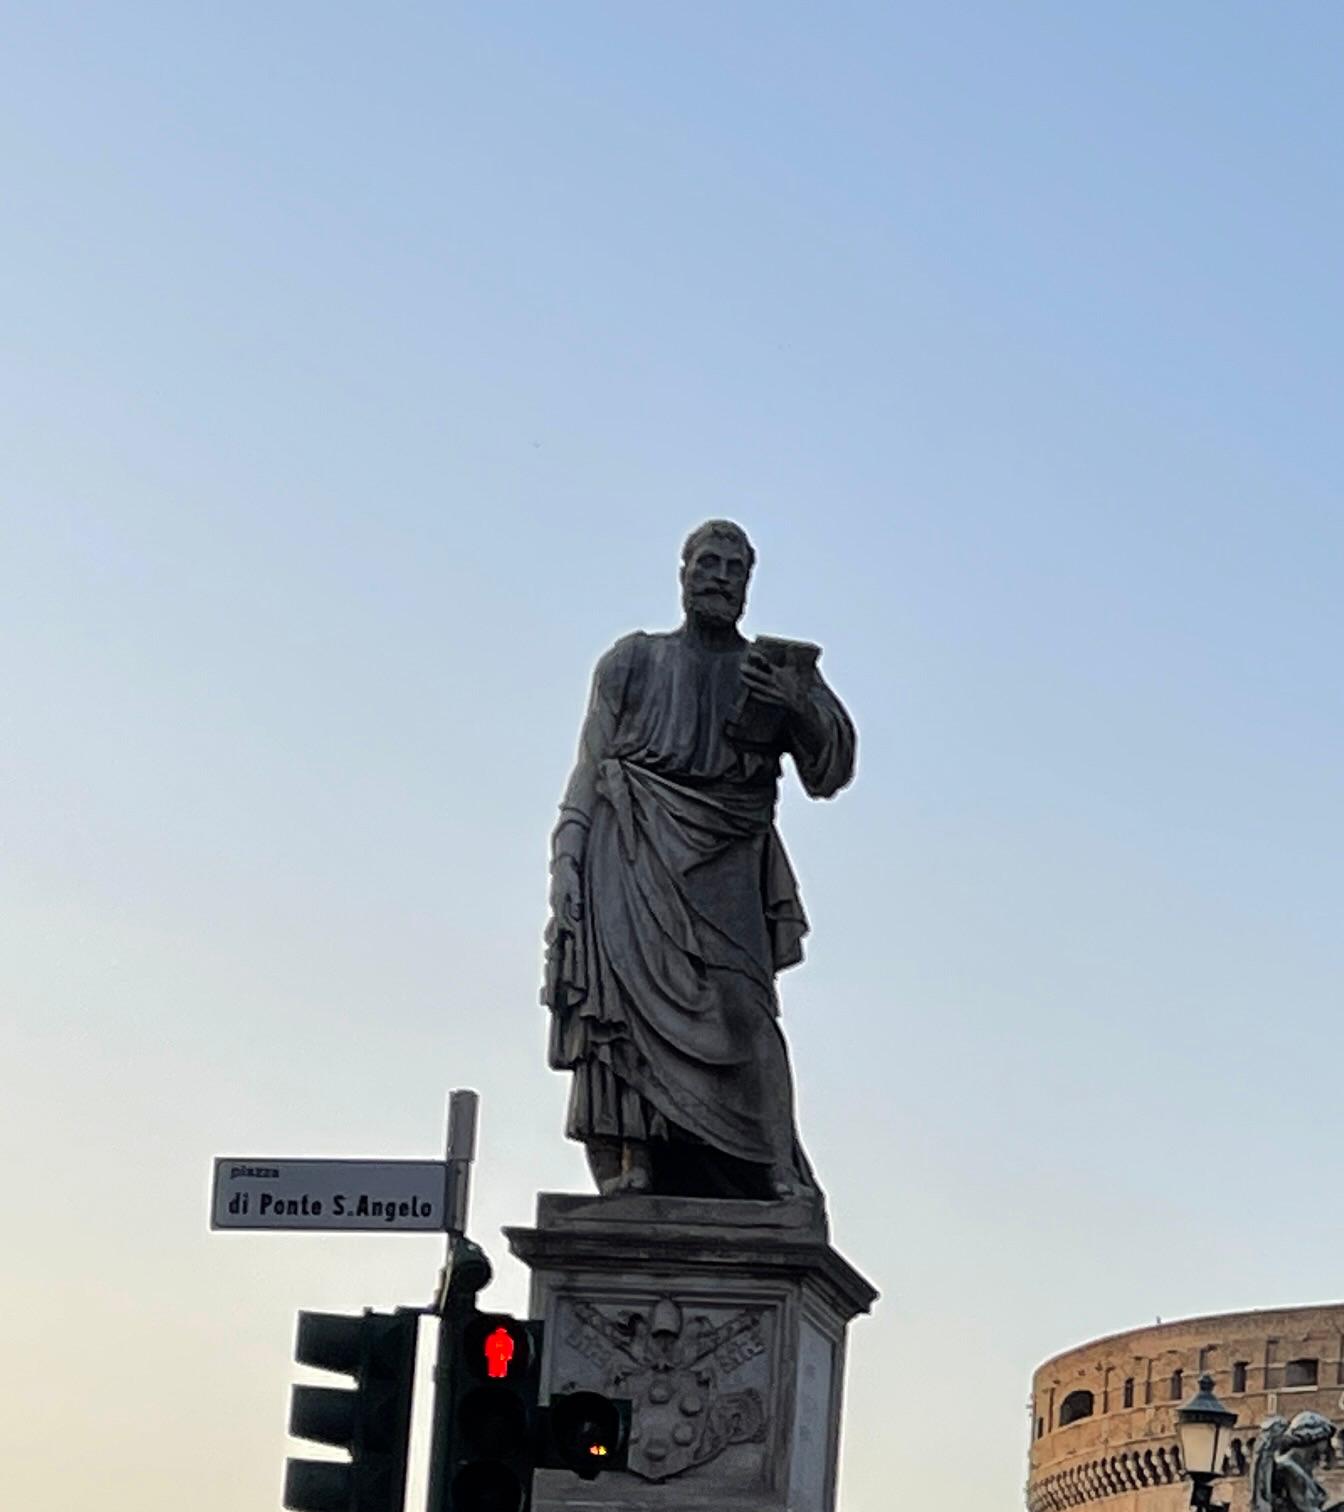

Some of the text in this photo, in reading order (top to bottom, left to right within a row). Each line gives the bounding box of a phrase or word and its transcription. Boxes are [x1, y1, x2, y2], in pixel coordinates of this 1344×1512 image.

[230, 1166, 279, 1179] piazza
[229, 1192, 248, 1214] di
[260, 1193, 322, 1216] Ponte
